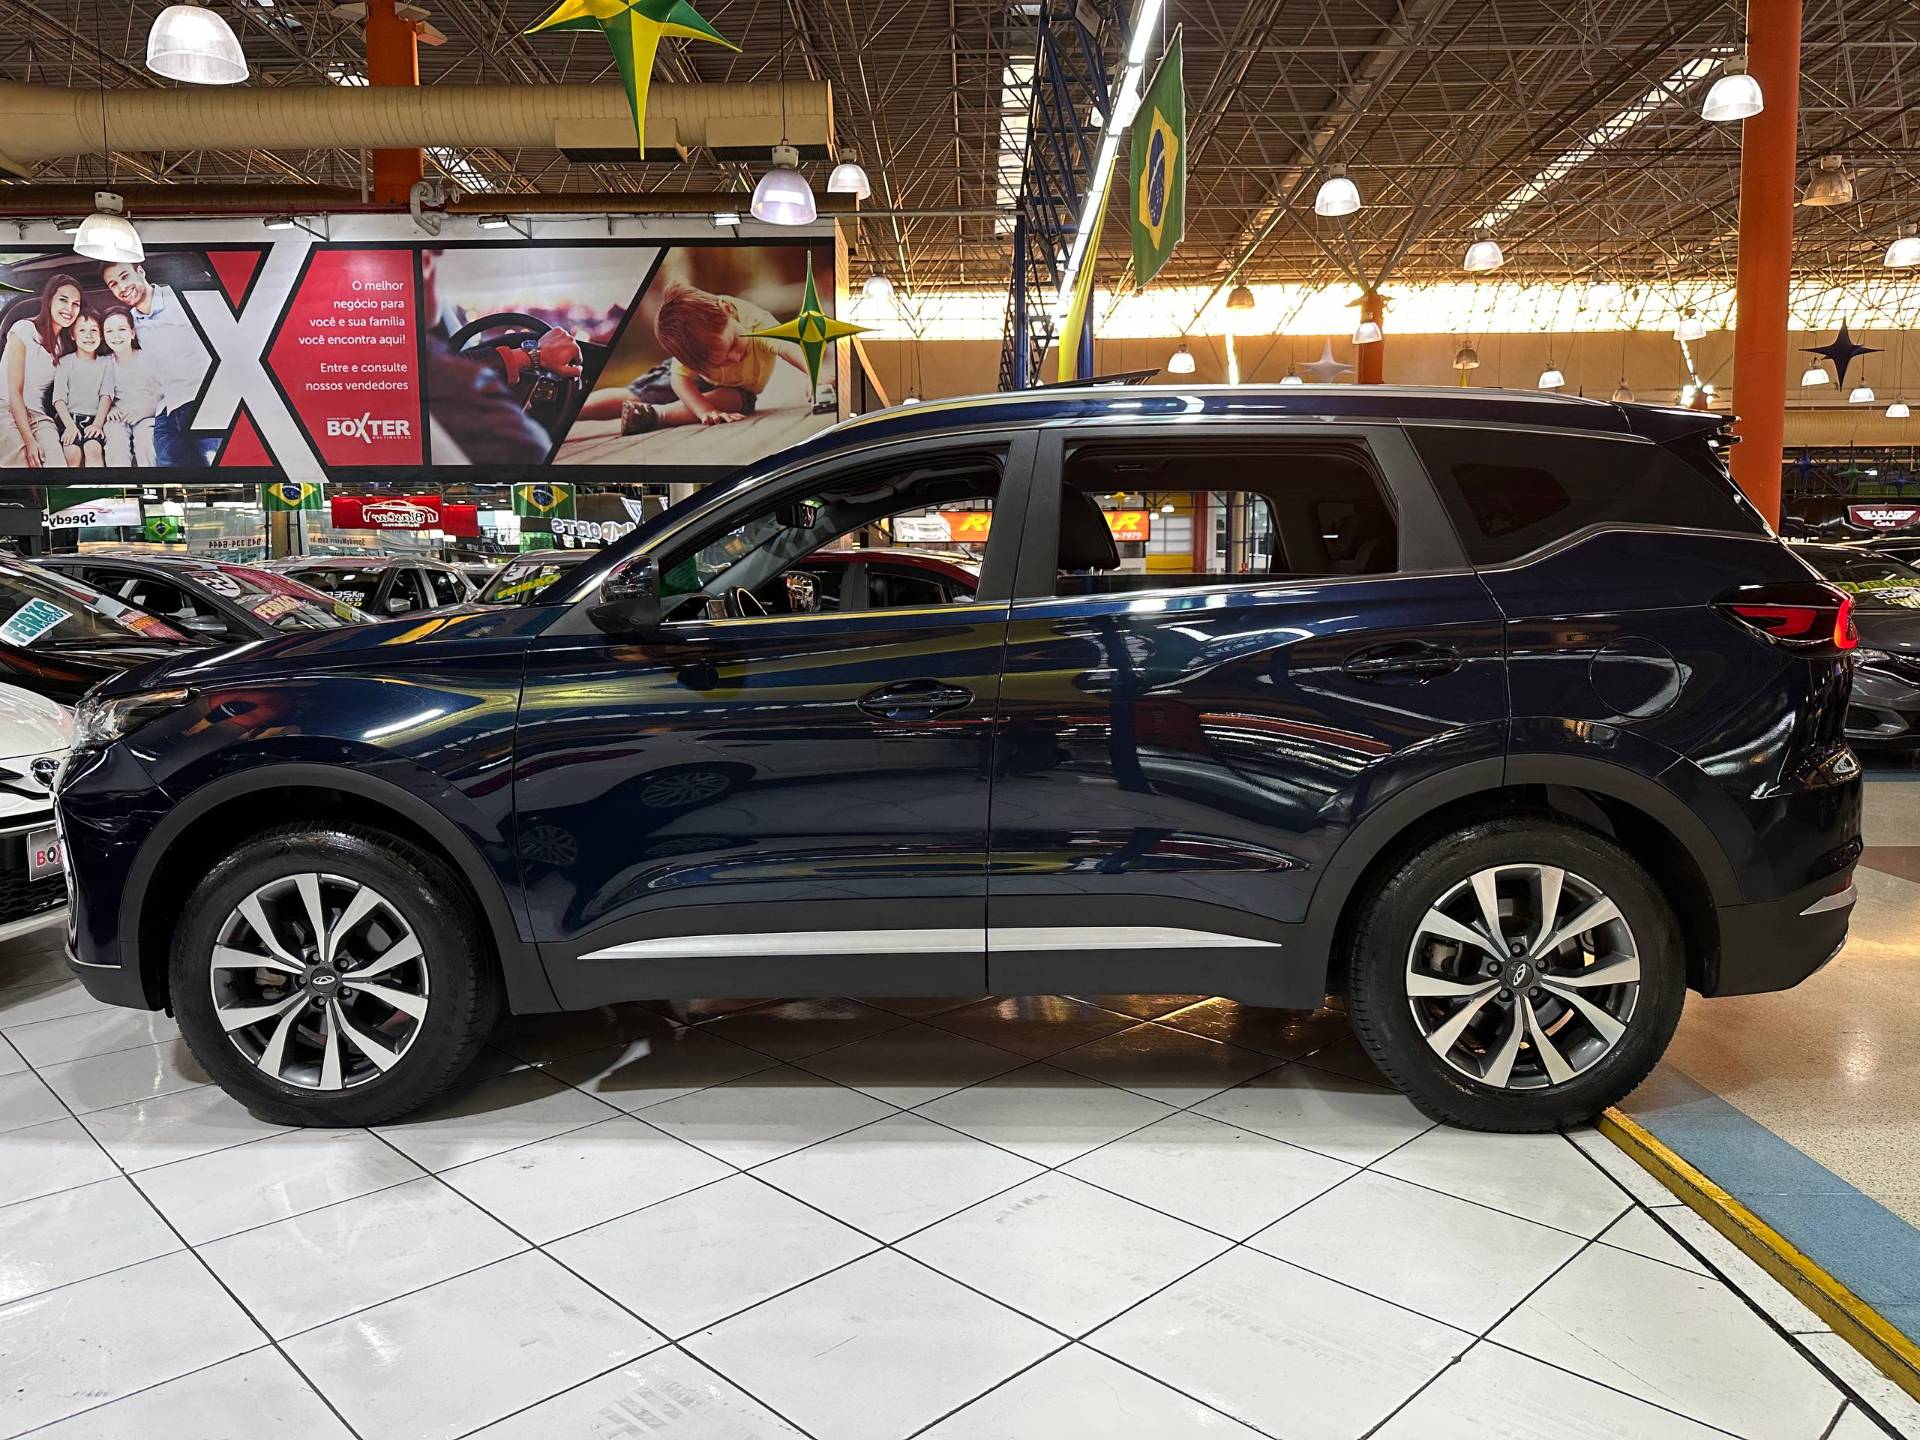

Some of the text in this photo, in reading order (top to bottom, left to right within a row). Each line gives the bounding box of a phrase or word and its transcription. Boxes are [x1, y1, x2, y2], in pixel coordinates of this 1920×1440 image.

[352, 280, 404, 291] O melhor
[333, 299, 405, 311] negócio para
[310, 316, 405, 327] você e sua família
[299, 334, 406, 347] você encontra aqui!
[320, 362, 408, 373] Entre e consulte
[305, 380, 409, 391] nossos vendedores
[326, 412, 411, 444] BOXTER
